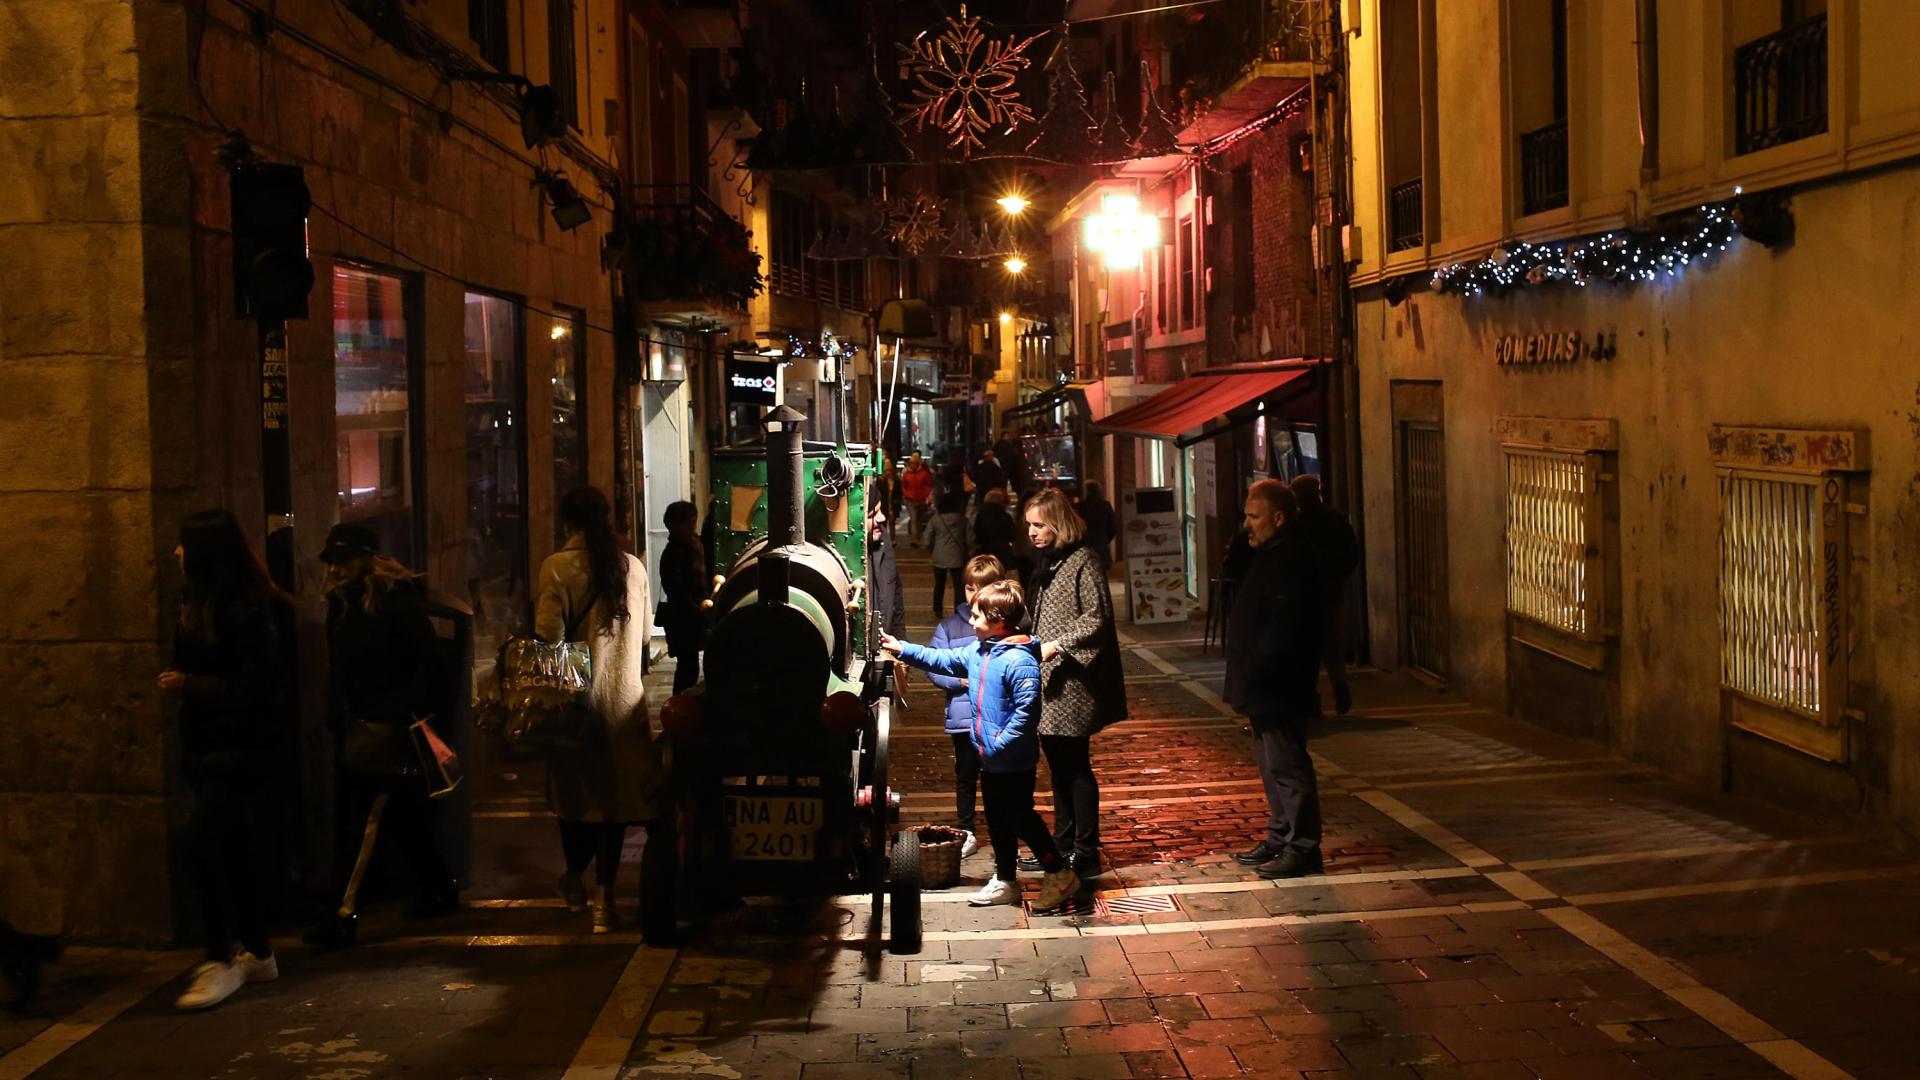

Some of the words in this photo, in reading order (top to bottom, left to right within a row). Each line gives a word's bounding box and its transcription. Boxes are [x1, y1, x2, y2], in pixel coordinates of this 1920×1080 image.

[1494, 331, 1577, 364] COMEDIAS
[741, 801, 770, 825] NA
[784, 801, 815, 825] AU
[744, 833, 808, 856] 2401
